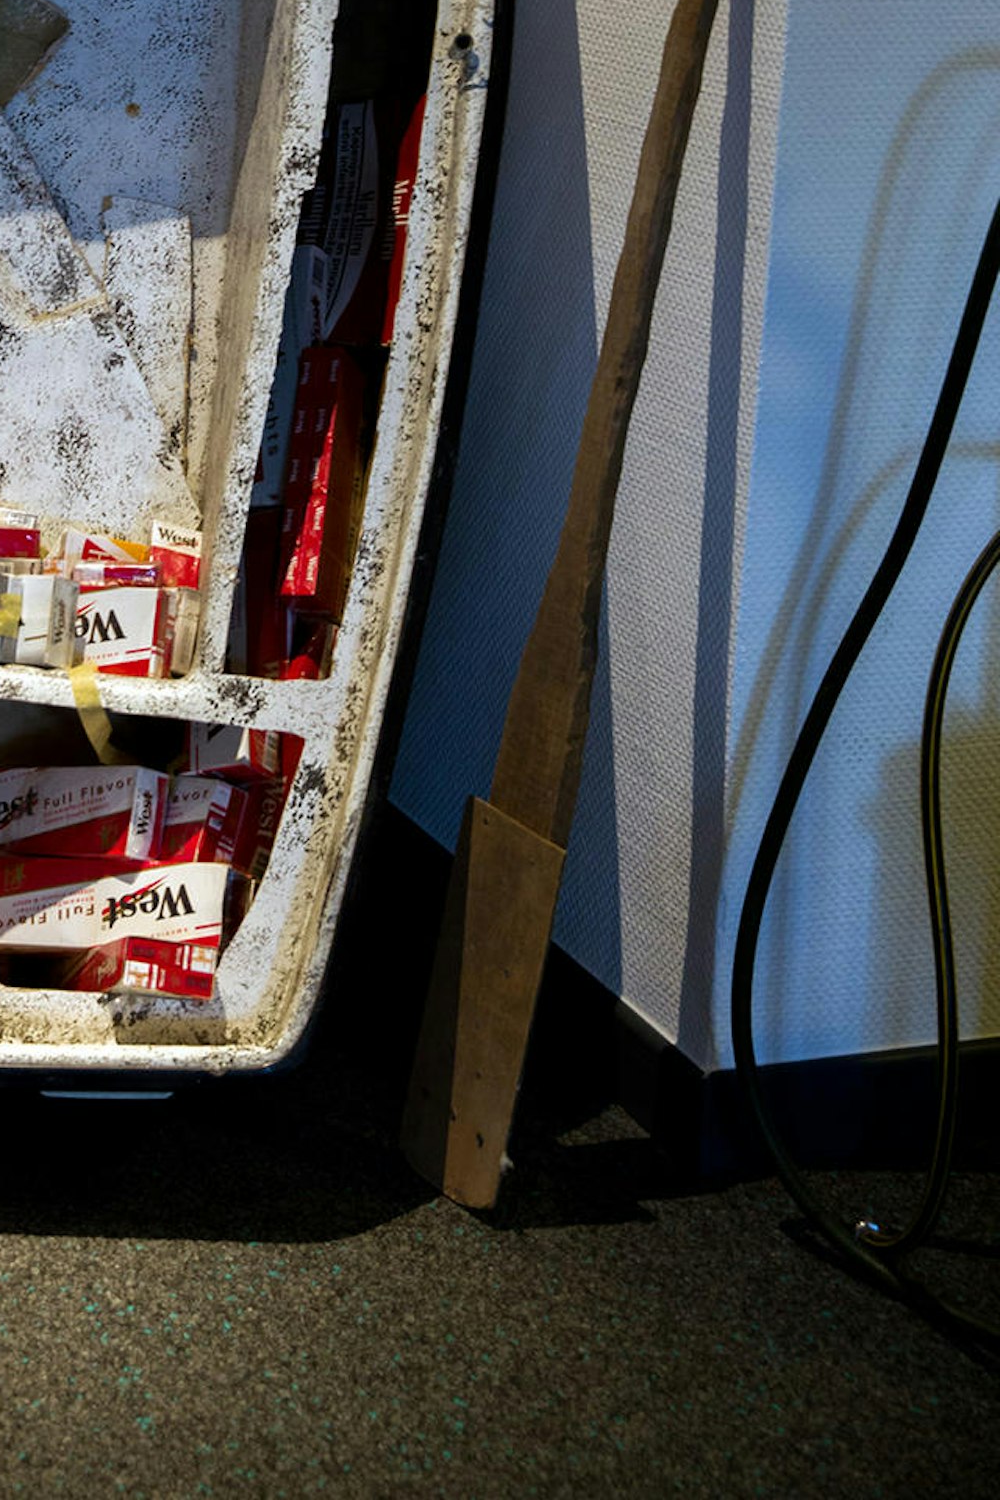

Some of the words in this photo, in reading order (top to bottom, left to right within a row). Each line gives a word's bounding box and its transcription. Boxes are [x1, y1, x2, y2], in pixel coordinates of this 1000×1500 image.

[264, 402, 280, 456] ghts
[158, 527, 199, 548] West
[74, 609, 127, 644] We
[44, 791, 73, 809] Full
[80, 777, 134, 799] Flavor
[136, 789, 153, 835] West
[57, 903, 96, 920] Full
[102, 884, 195, 930] West
